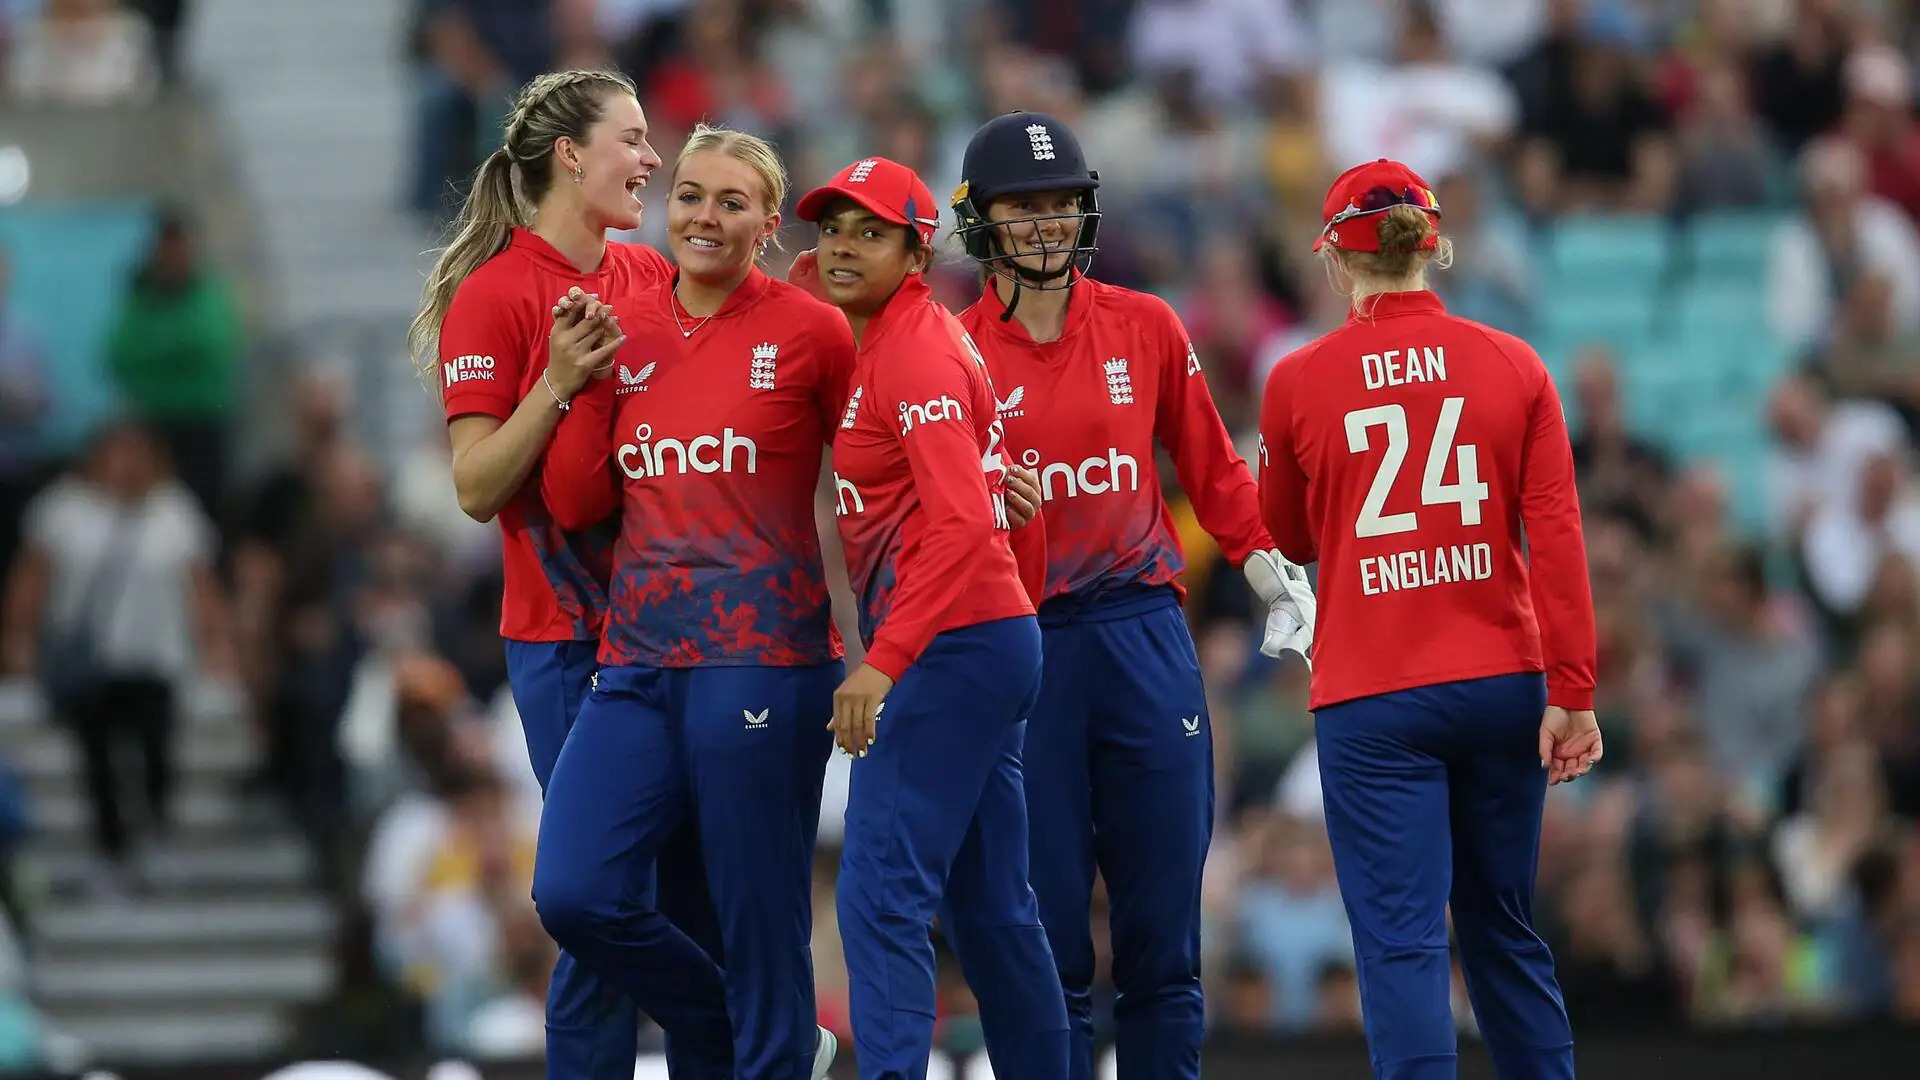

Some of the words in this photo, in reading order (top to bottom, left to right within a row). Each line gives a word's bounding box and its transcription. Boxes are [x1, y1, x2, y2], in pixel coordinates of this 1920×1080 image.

[444, 354, 495, 388] METRO
[459, 371, 495, 381] BANK
[615, 385, 649, 395] CASTORE
[1361, 346, 1447, 390] DEAN
[617, 423, 757, 480] cinch
[1022, 447, 1138, 501] inch
[1344, 397, 1489, 538] 24
[1359, 542, 1492, 596] ENGLAND
